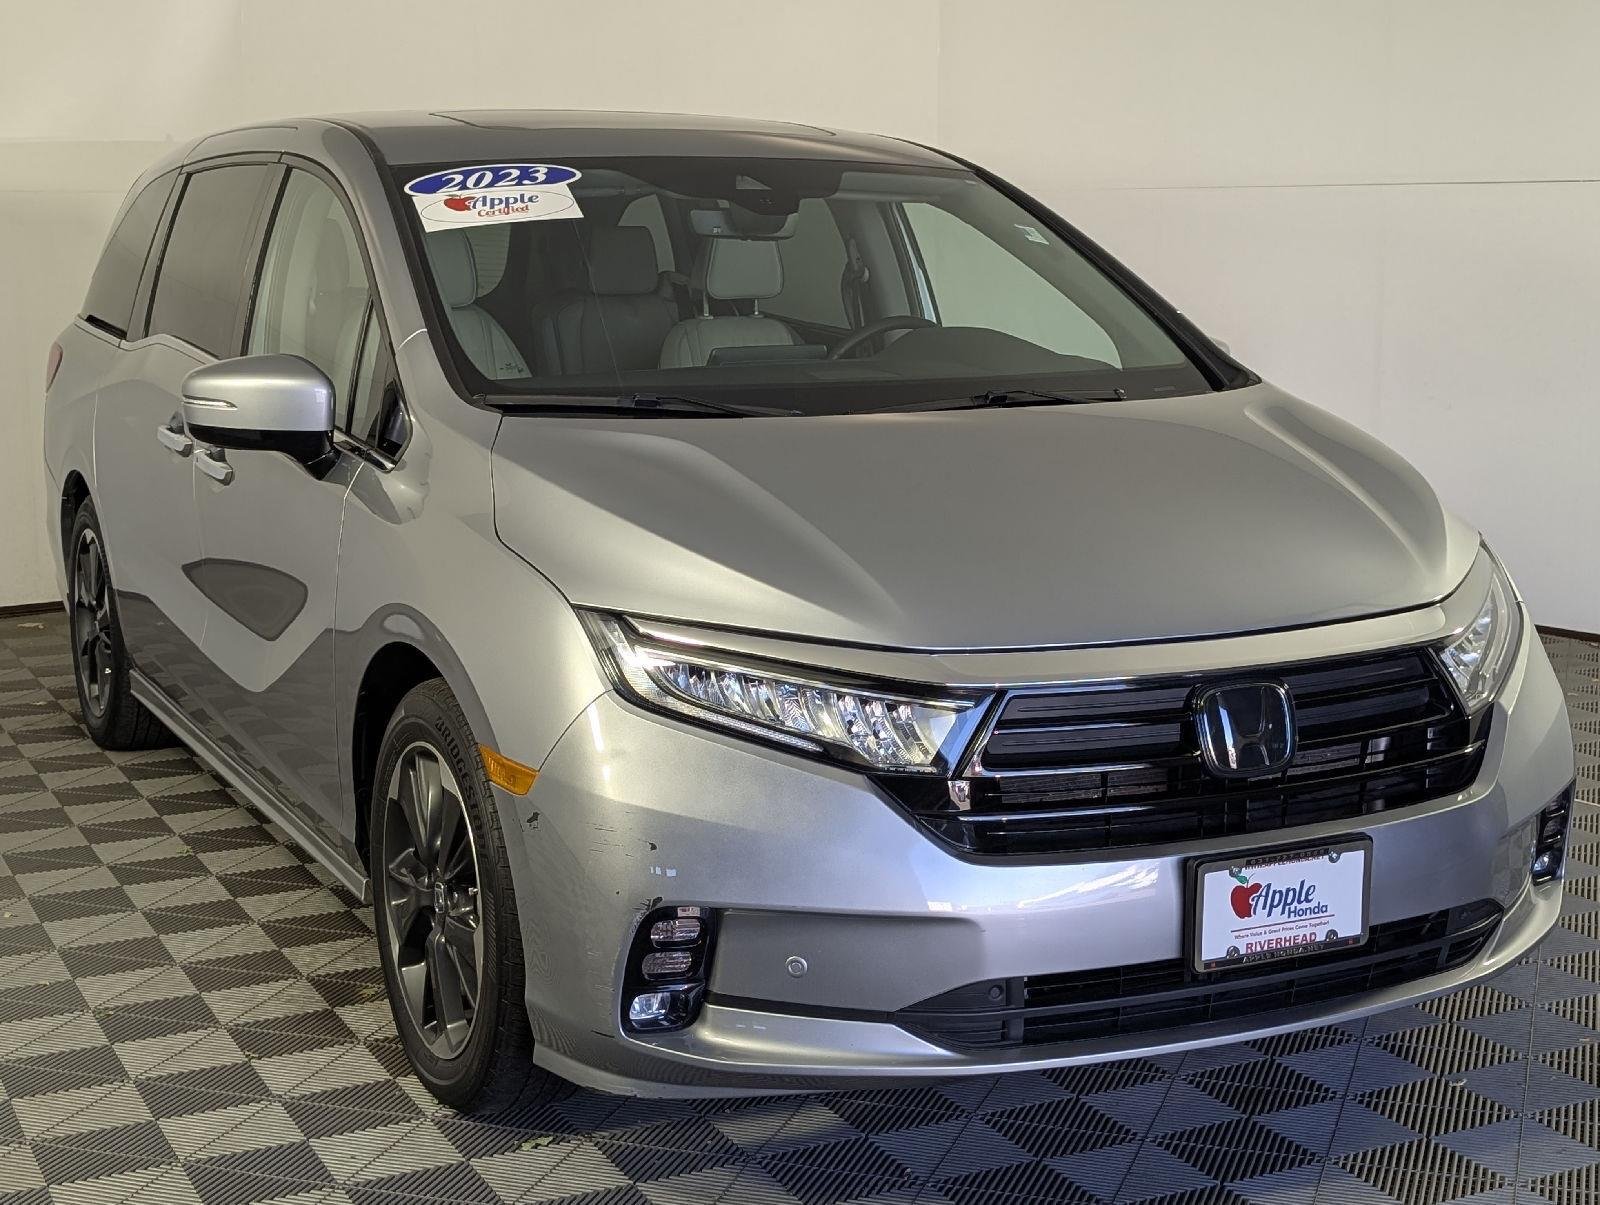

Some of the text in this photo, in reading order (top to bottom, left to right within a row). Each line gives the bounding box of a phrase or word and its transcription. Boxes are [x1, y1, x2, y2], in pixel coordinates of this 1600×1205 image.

[437, 167, 548, 193] 2023
[470, 193, 539, 210] Apple
[477, 204, 530, 217] Certified
[1250, 879, 1316, 918] Apple
[1287, 901, 1328, 919] Honda
[1245, 931, 1317, 954] RIVERHEAD
